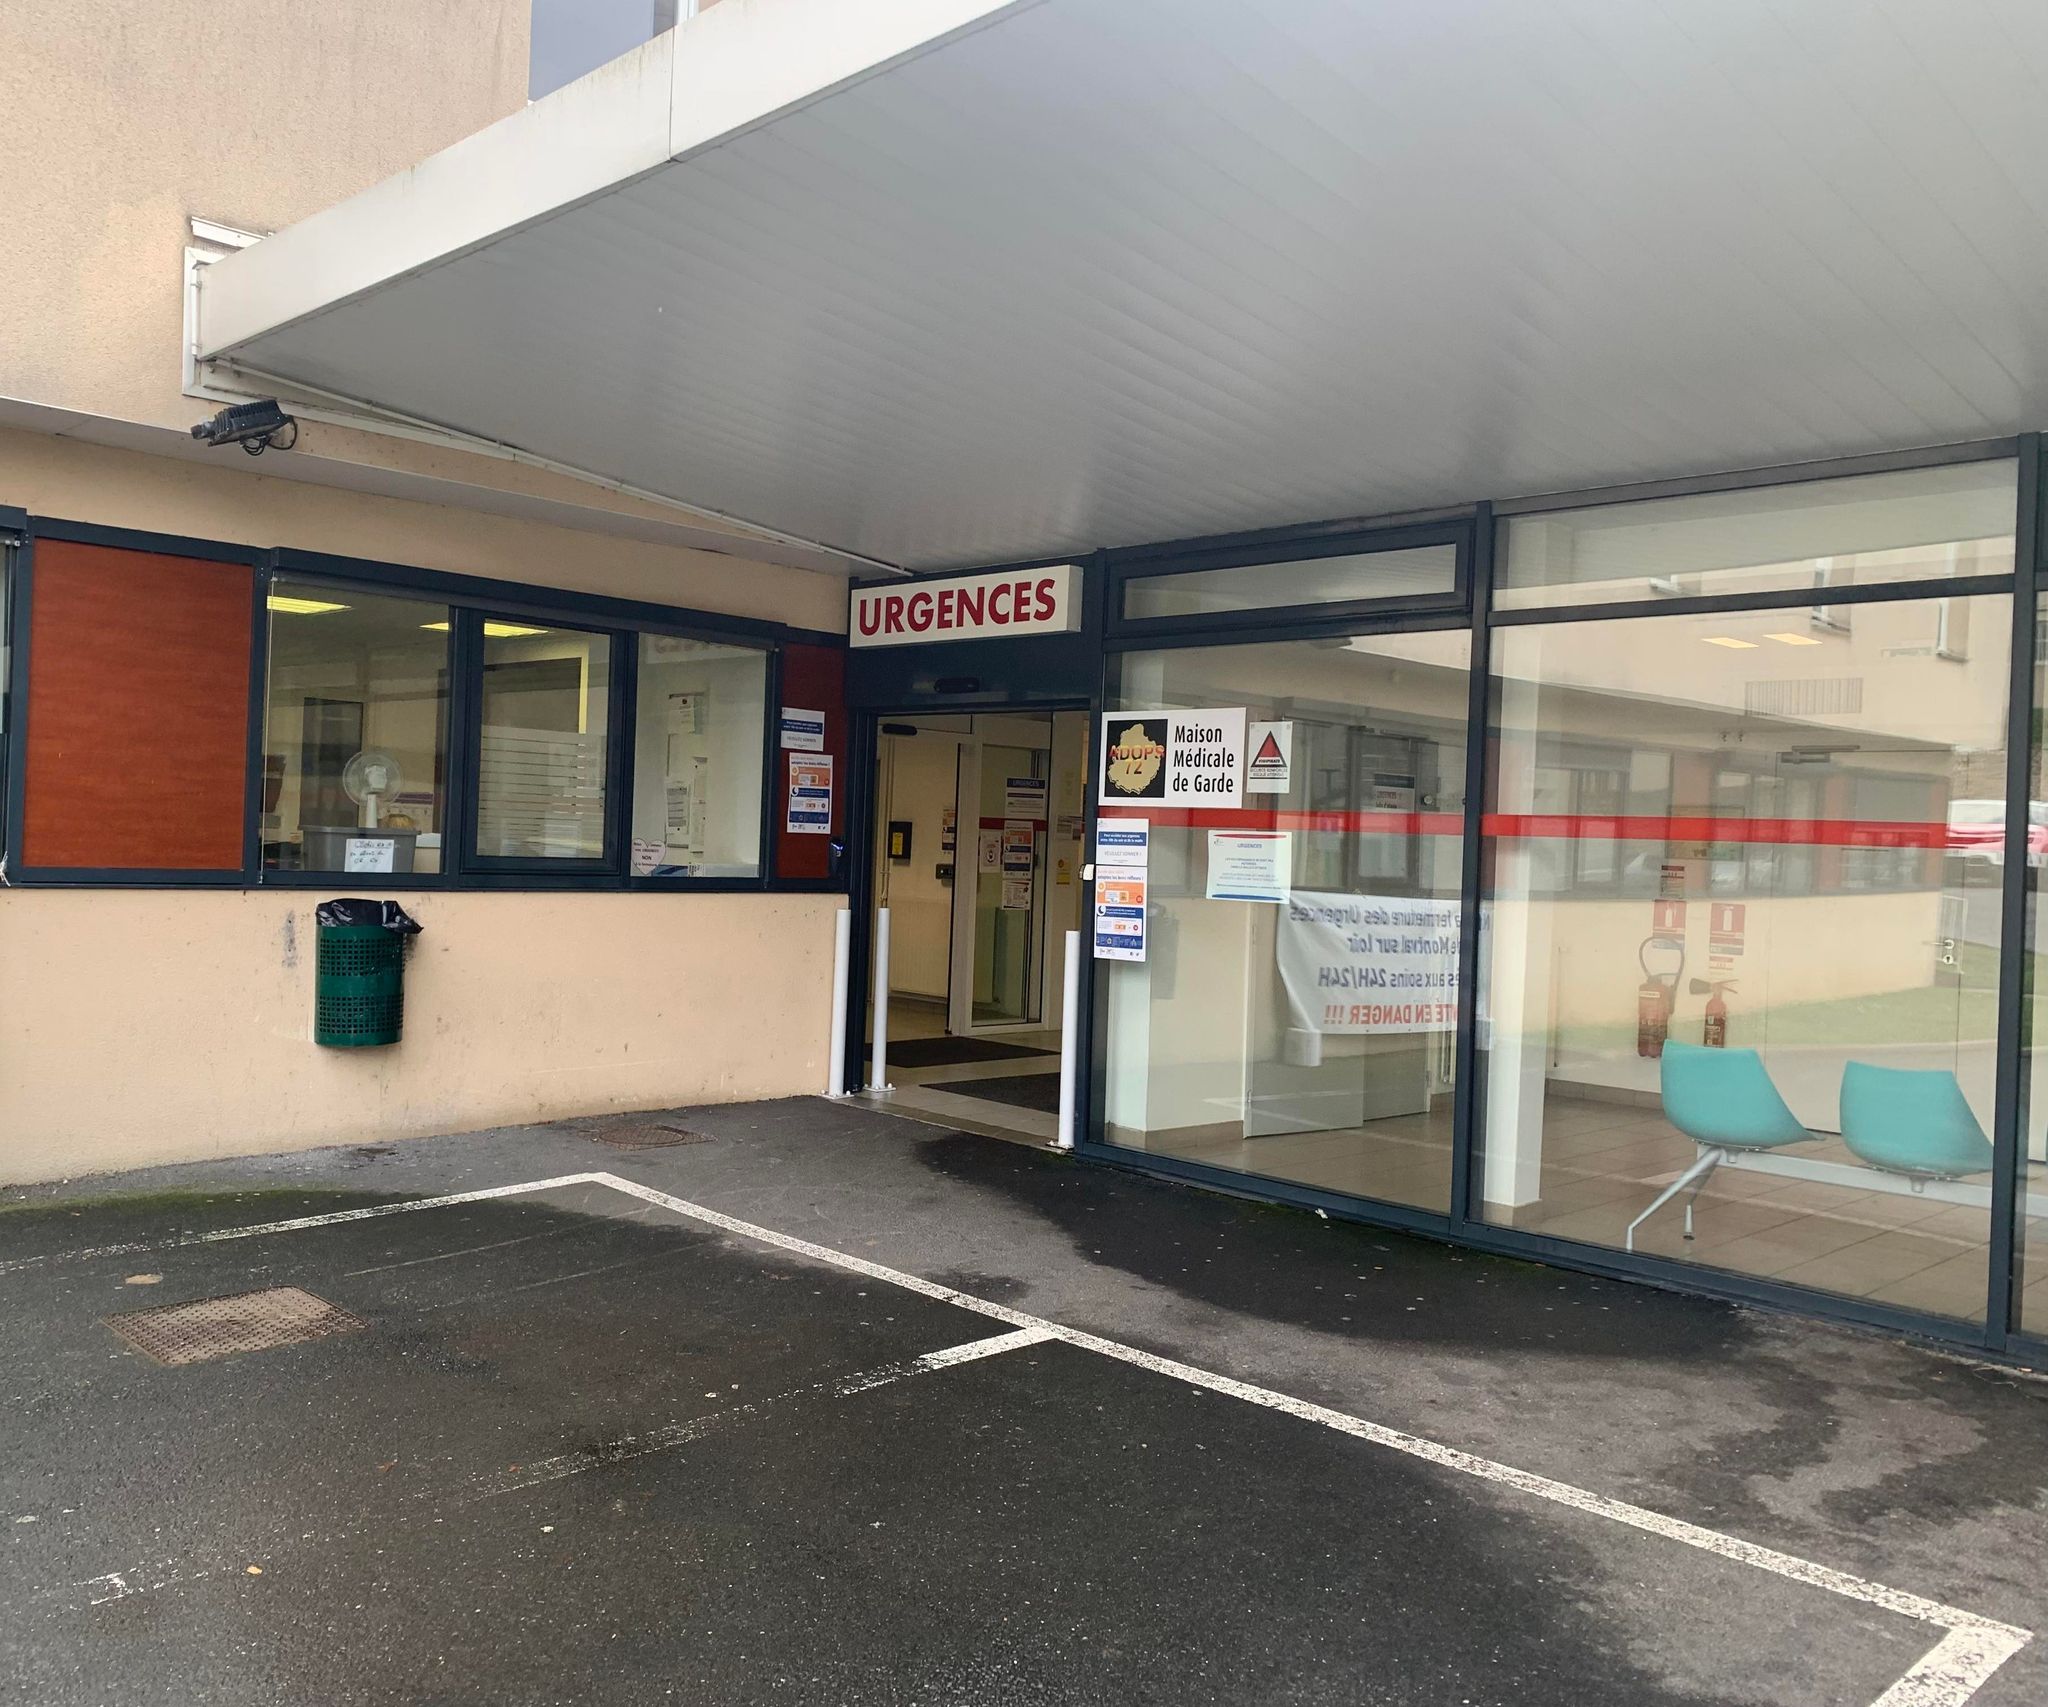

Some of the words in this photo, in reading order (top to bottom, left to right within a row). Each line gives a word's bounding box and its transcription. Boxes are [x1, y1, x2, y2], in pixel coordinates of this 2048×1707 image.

[859, 578, 1056, 636] URGENCES
[1174, 723, 1222, 743] Maison
[1109, 744, 1165, 761] ADOPS
[1173, 747, 1235, 768] Médicale
[1125, 760, 1143, 775] 72
[1172, 772, 1189, 792] de
[1194, 772, 1234, 793] Garde
